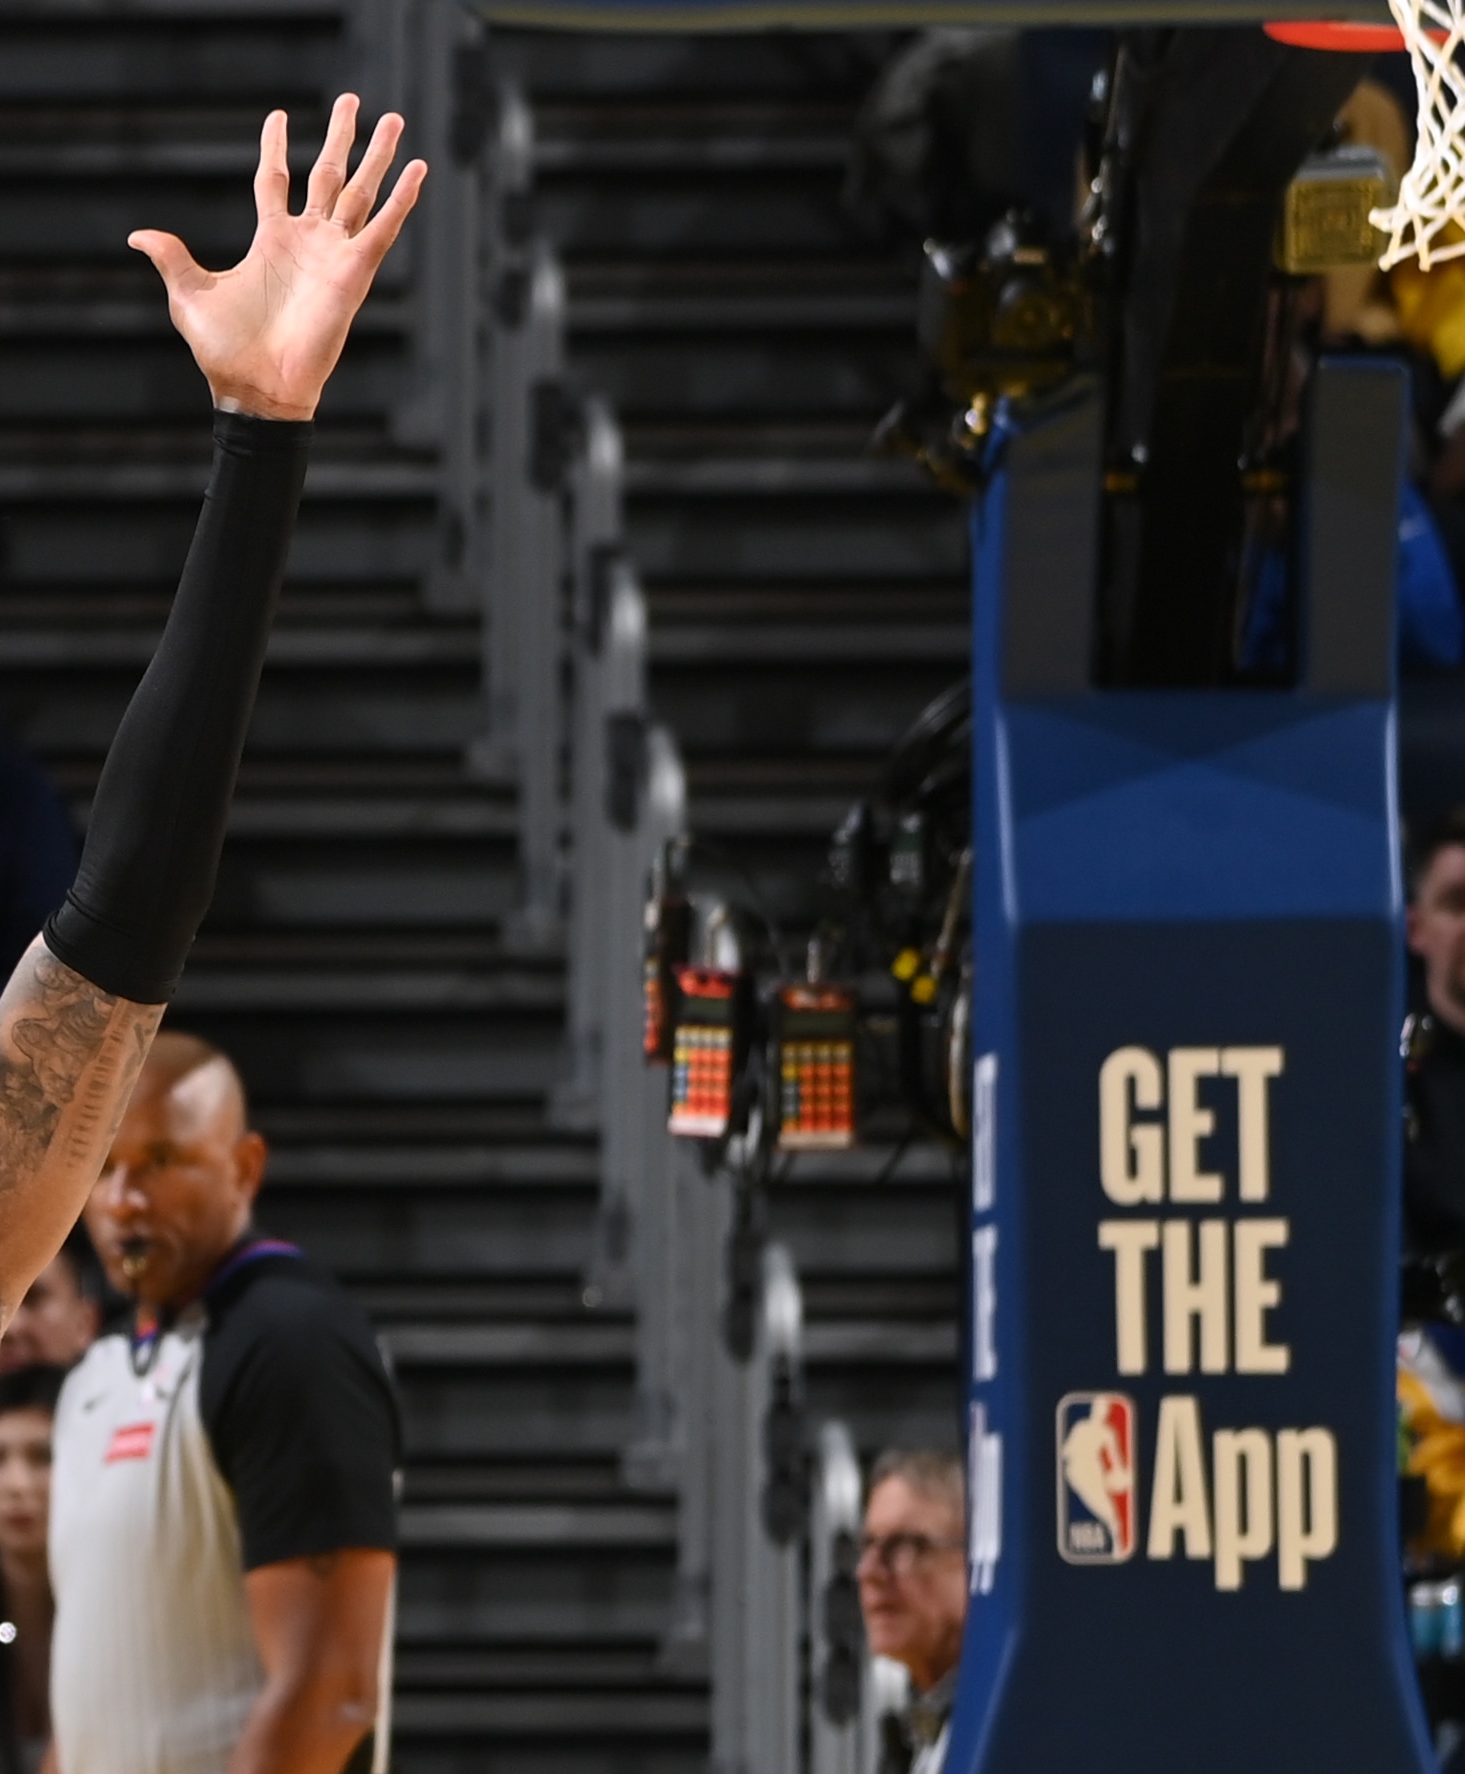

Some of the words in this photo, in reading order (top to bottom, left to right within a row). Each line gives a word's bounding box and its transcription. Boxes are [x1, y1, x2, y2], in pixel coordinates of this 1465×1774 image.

[1099, 1046, 1283, 1205] GET
[1097, 1220, 1290, 1376] THE
[1147, 1394, 1339, 1593] App
